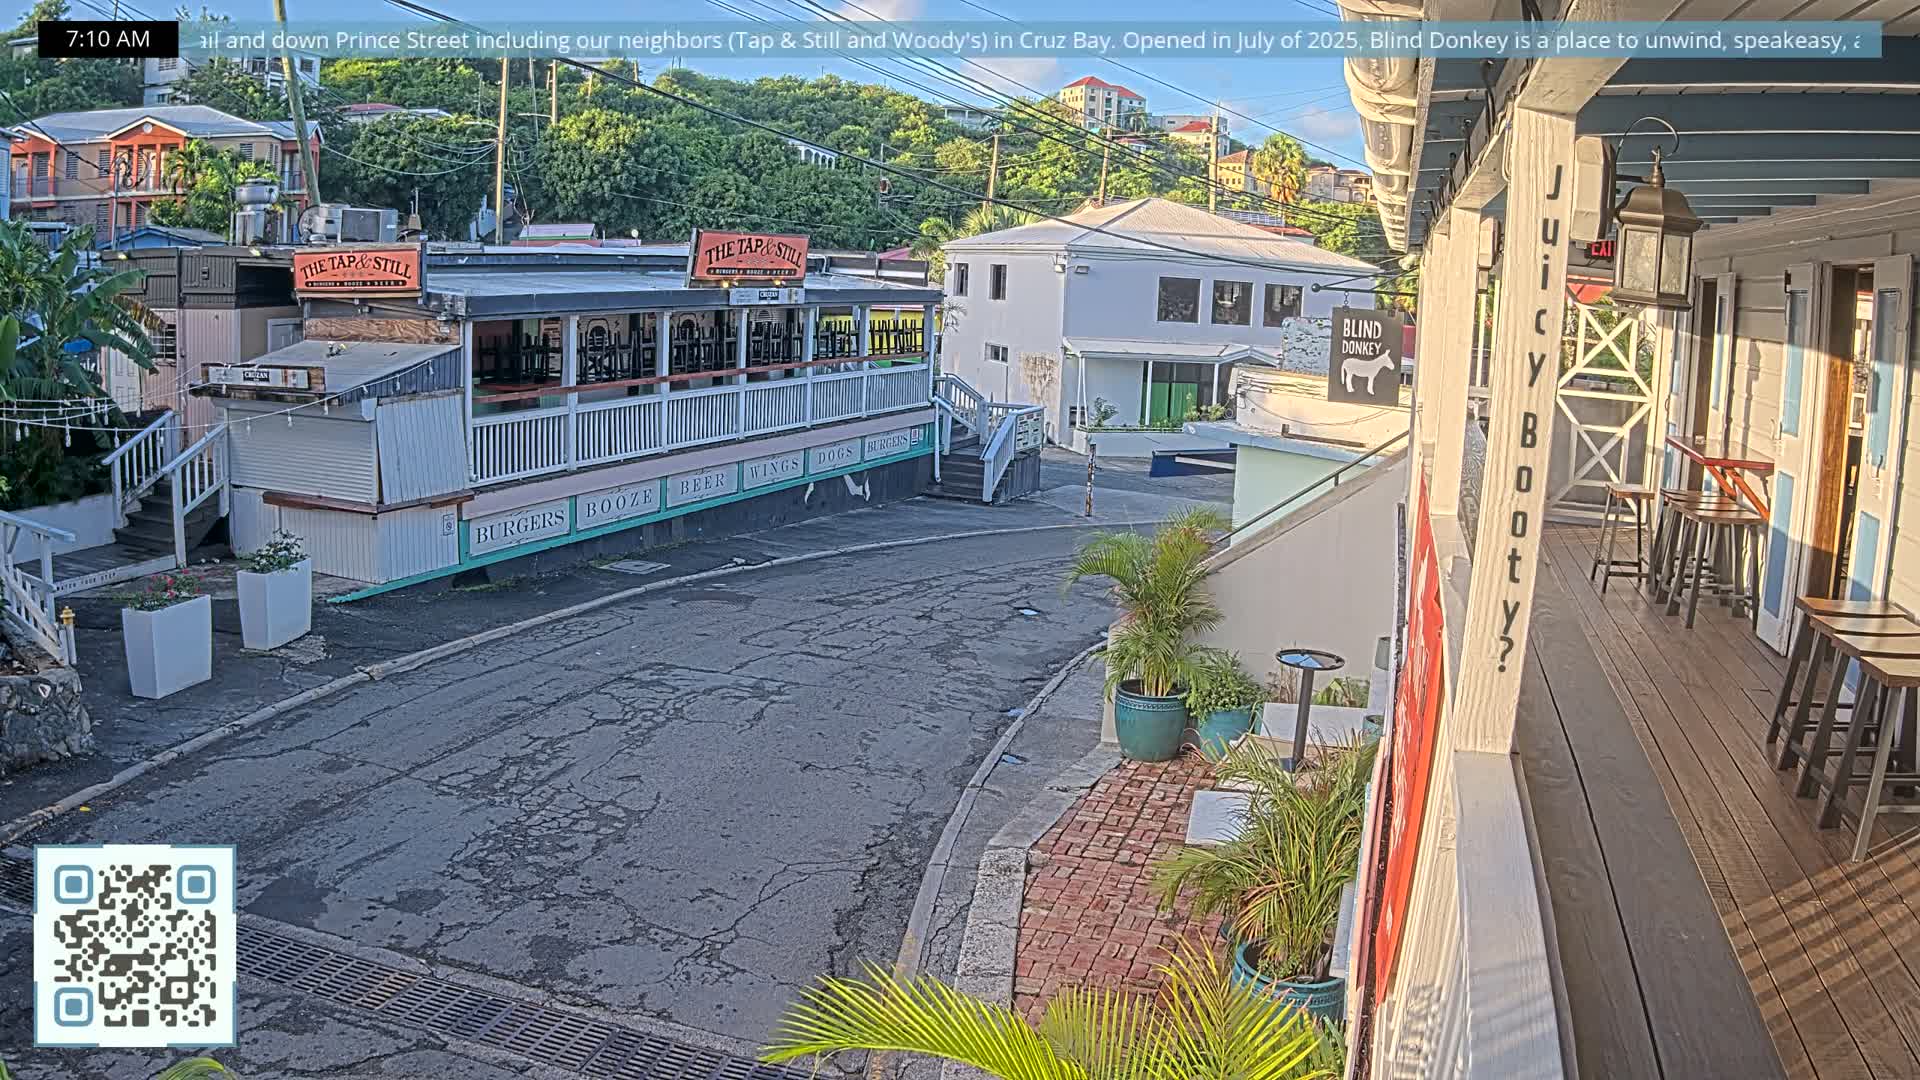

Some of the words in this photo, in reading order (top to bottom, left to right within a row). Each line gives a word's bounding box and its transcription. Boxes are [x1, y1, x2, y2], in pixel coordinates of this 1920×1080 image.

[705, 240, 735, 265] THE
[737, 237, 763, 254] TAP
[761, 238, 777, 257] &
[775, 241, 802, 268] STILL
[300, 259, 328, 280] THE
[328, 255, 356, 271] TAP
[355, 253, 373, 270] &
[372, 256, 412, 279] STILL
[1528, 164, 1563, 388] Juicy
[1343, 318, 1382, 339] BLIND
[1342, 340, 1382, 356] DONKEY
[244, 371, 269, 379] CRUZAN
[867, 433, 909, 453] BURGERS
[818, 446, 853, 465] DOGS
[750, 458, 799, 480] WINGS
[680, 473, 726, 496] BEER
[586, 488, 653, 518] BOOZE
[475, 509, 565, 544] BURGERS
[1498, 411, 1537, 673] Booty?
